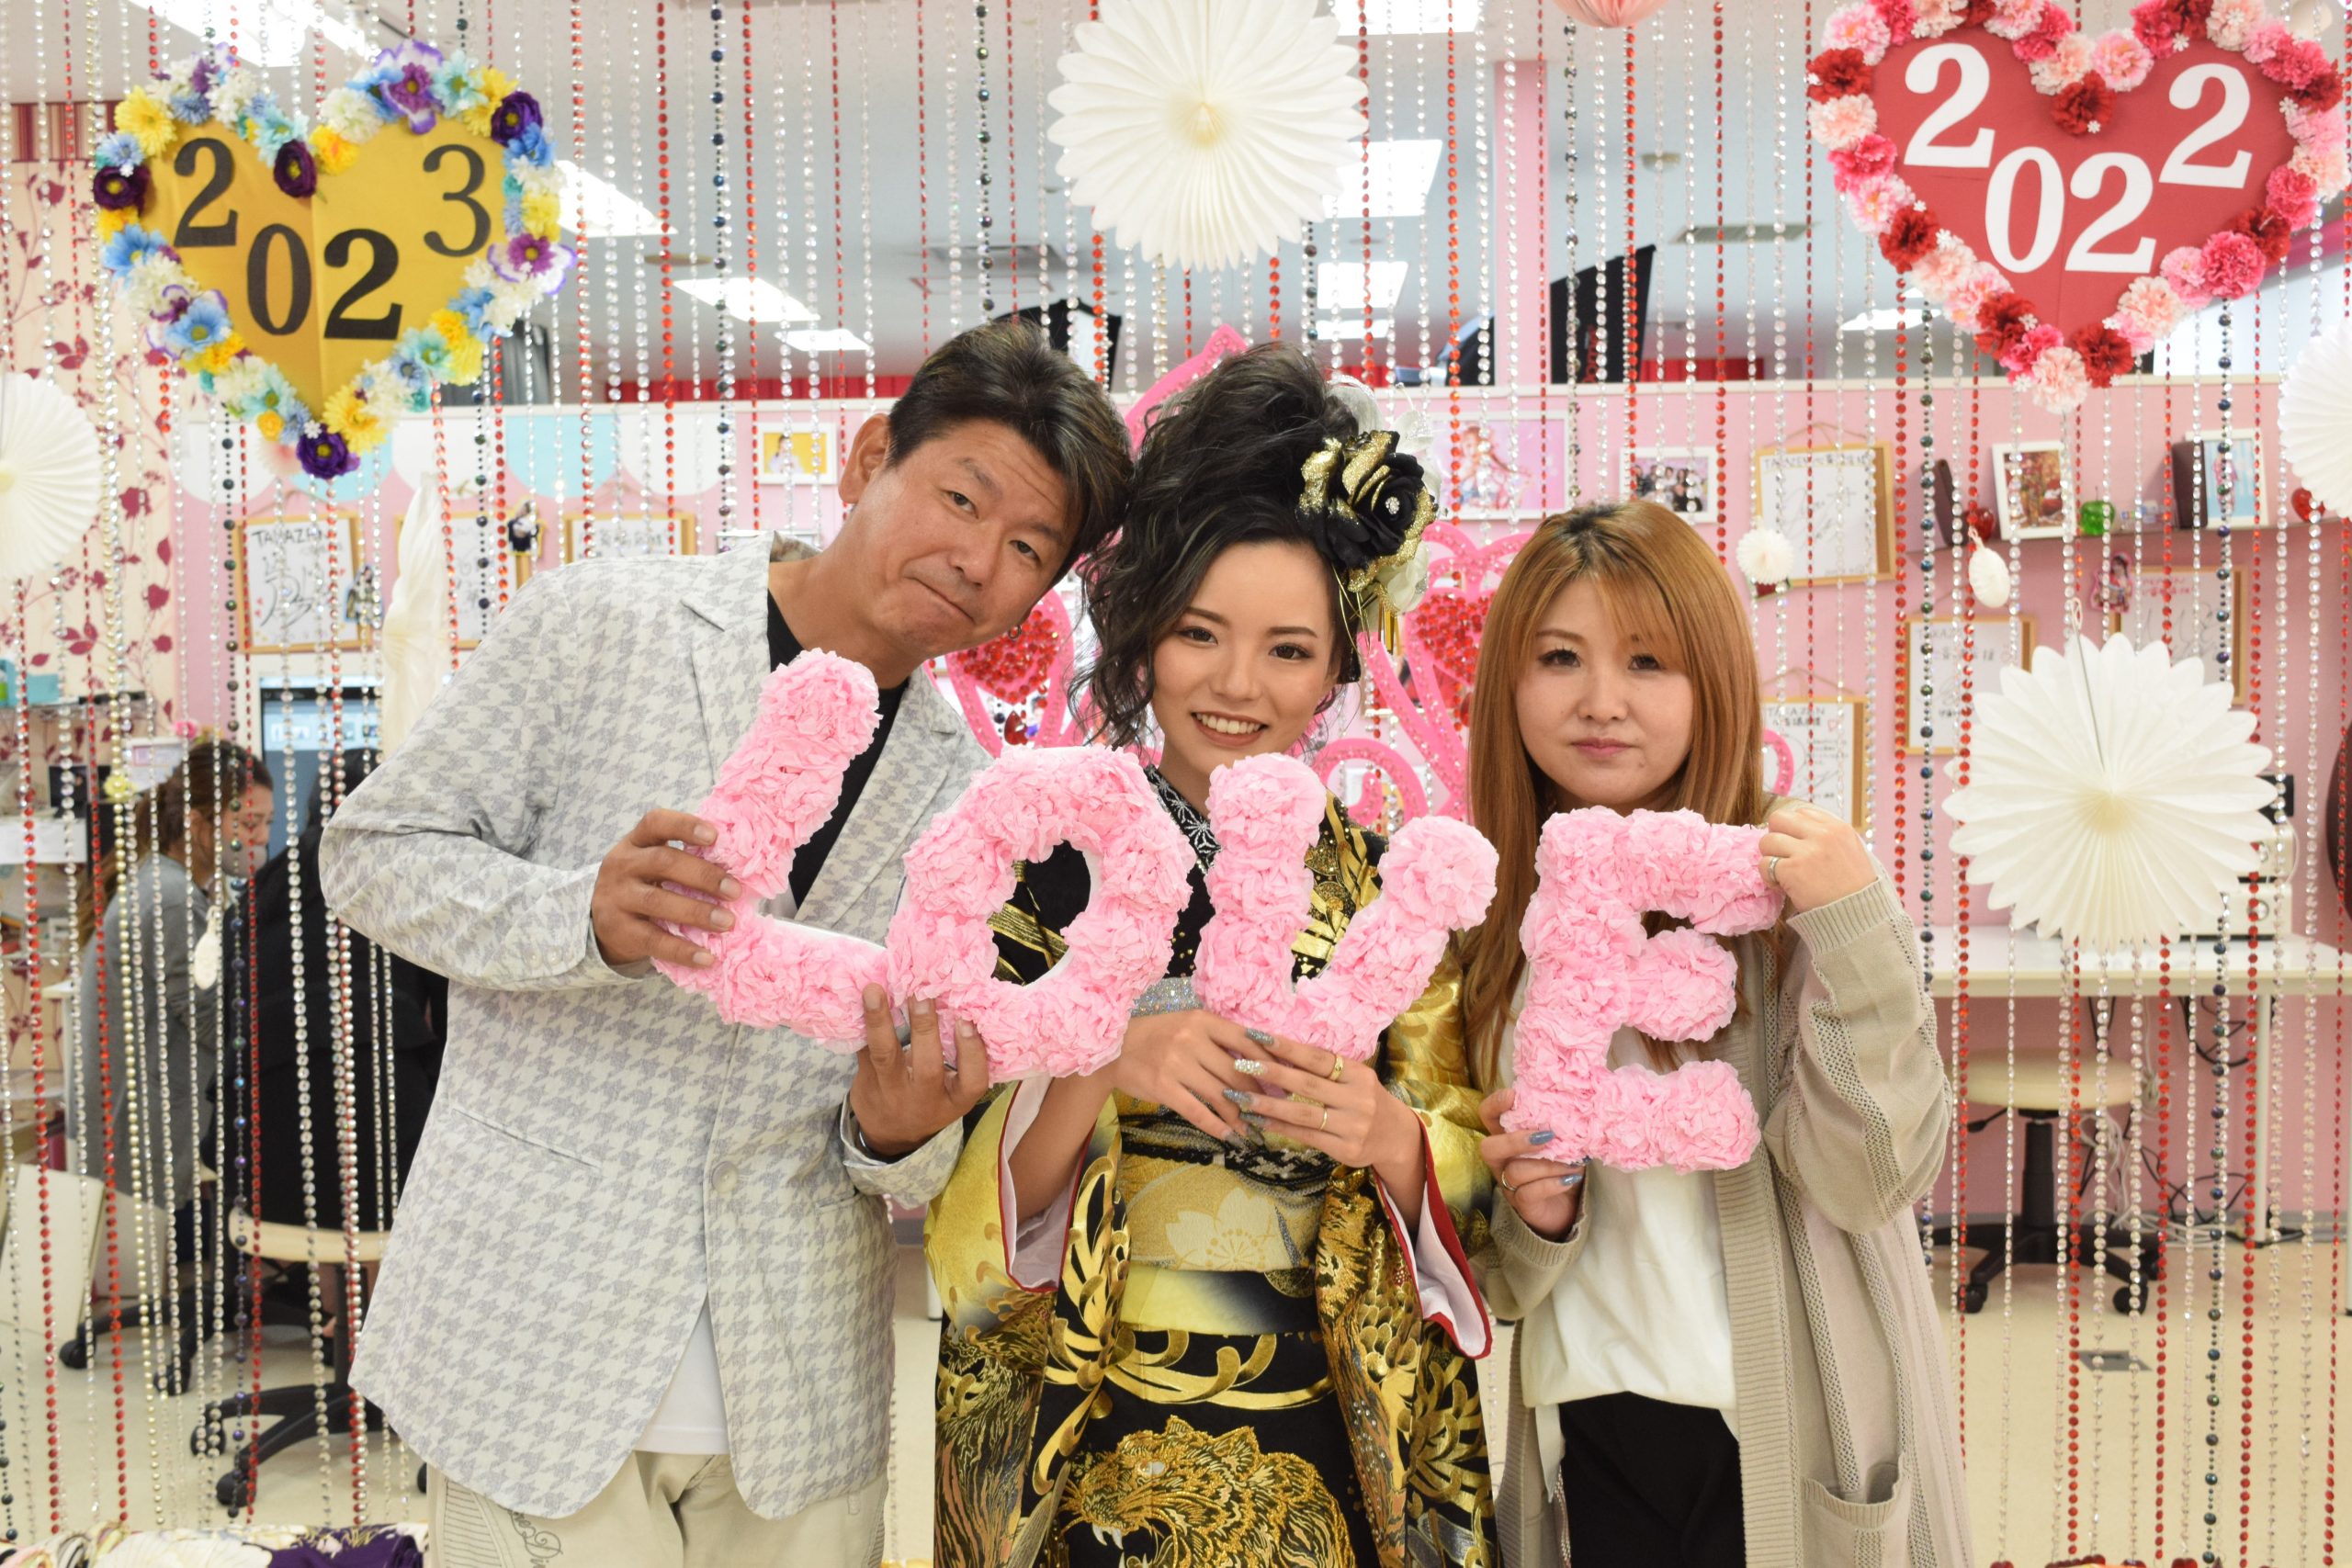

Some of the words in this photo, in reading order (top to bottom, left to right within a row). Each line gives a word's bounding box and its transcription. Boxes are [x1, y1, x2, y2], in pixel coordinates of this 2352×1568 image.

[173, 137, 492, 340] 2023
[1904, 43, 2253, 274] 2022
[656, 648, 1784, 1172] LOVE
